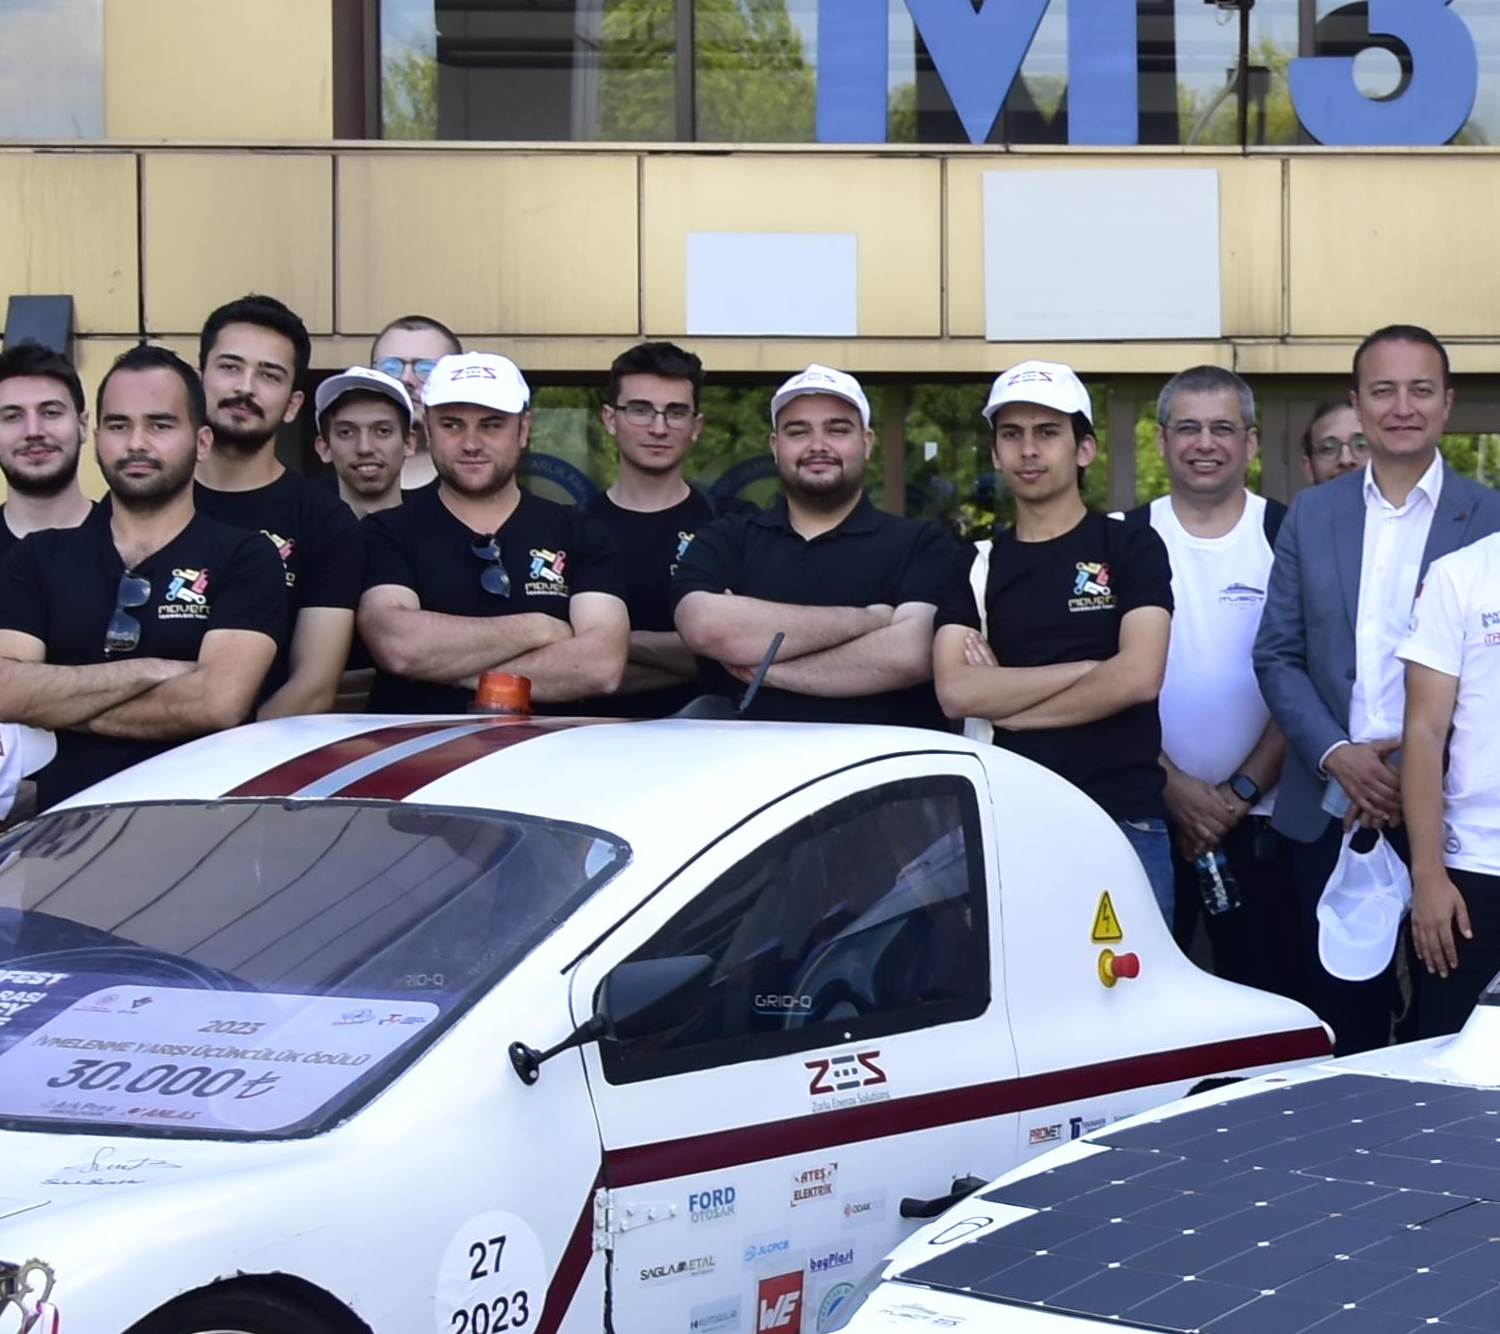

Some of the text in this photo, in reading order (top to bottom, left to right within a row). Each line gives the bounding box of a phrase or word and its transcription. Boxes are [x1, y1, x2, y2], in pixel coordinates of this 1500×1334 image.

[199, 1020, 266, 1035] 2023
[804, 1050, 888, 1096] ZES
[689, 1186, 736, 1212] FORD
[691, 1205, 735, 1224] OTOSAN
[469, 1234, 508, 1280] 27
[759, 1290, 801, 1331] WE
